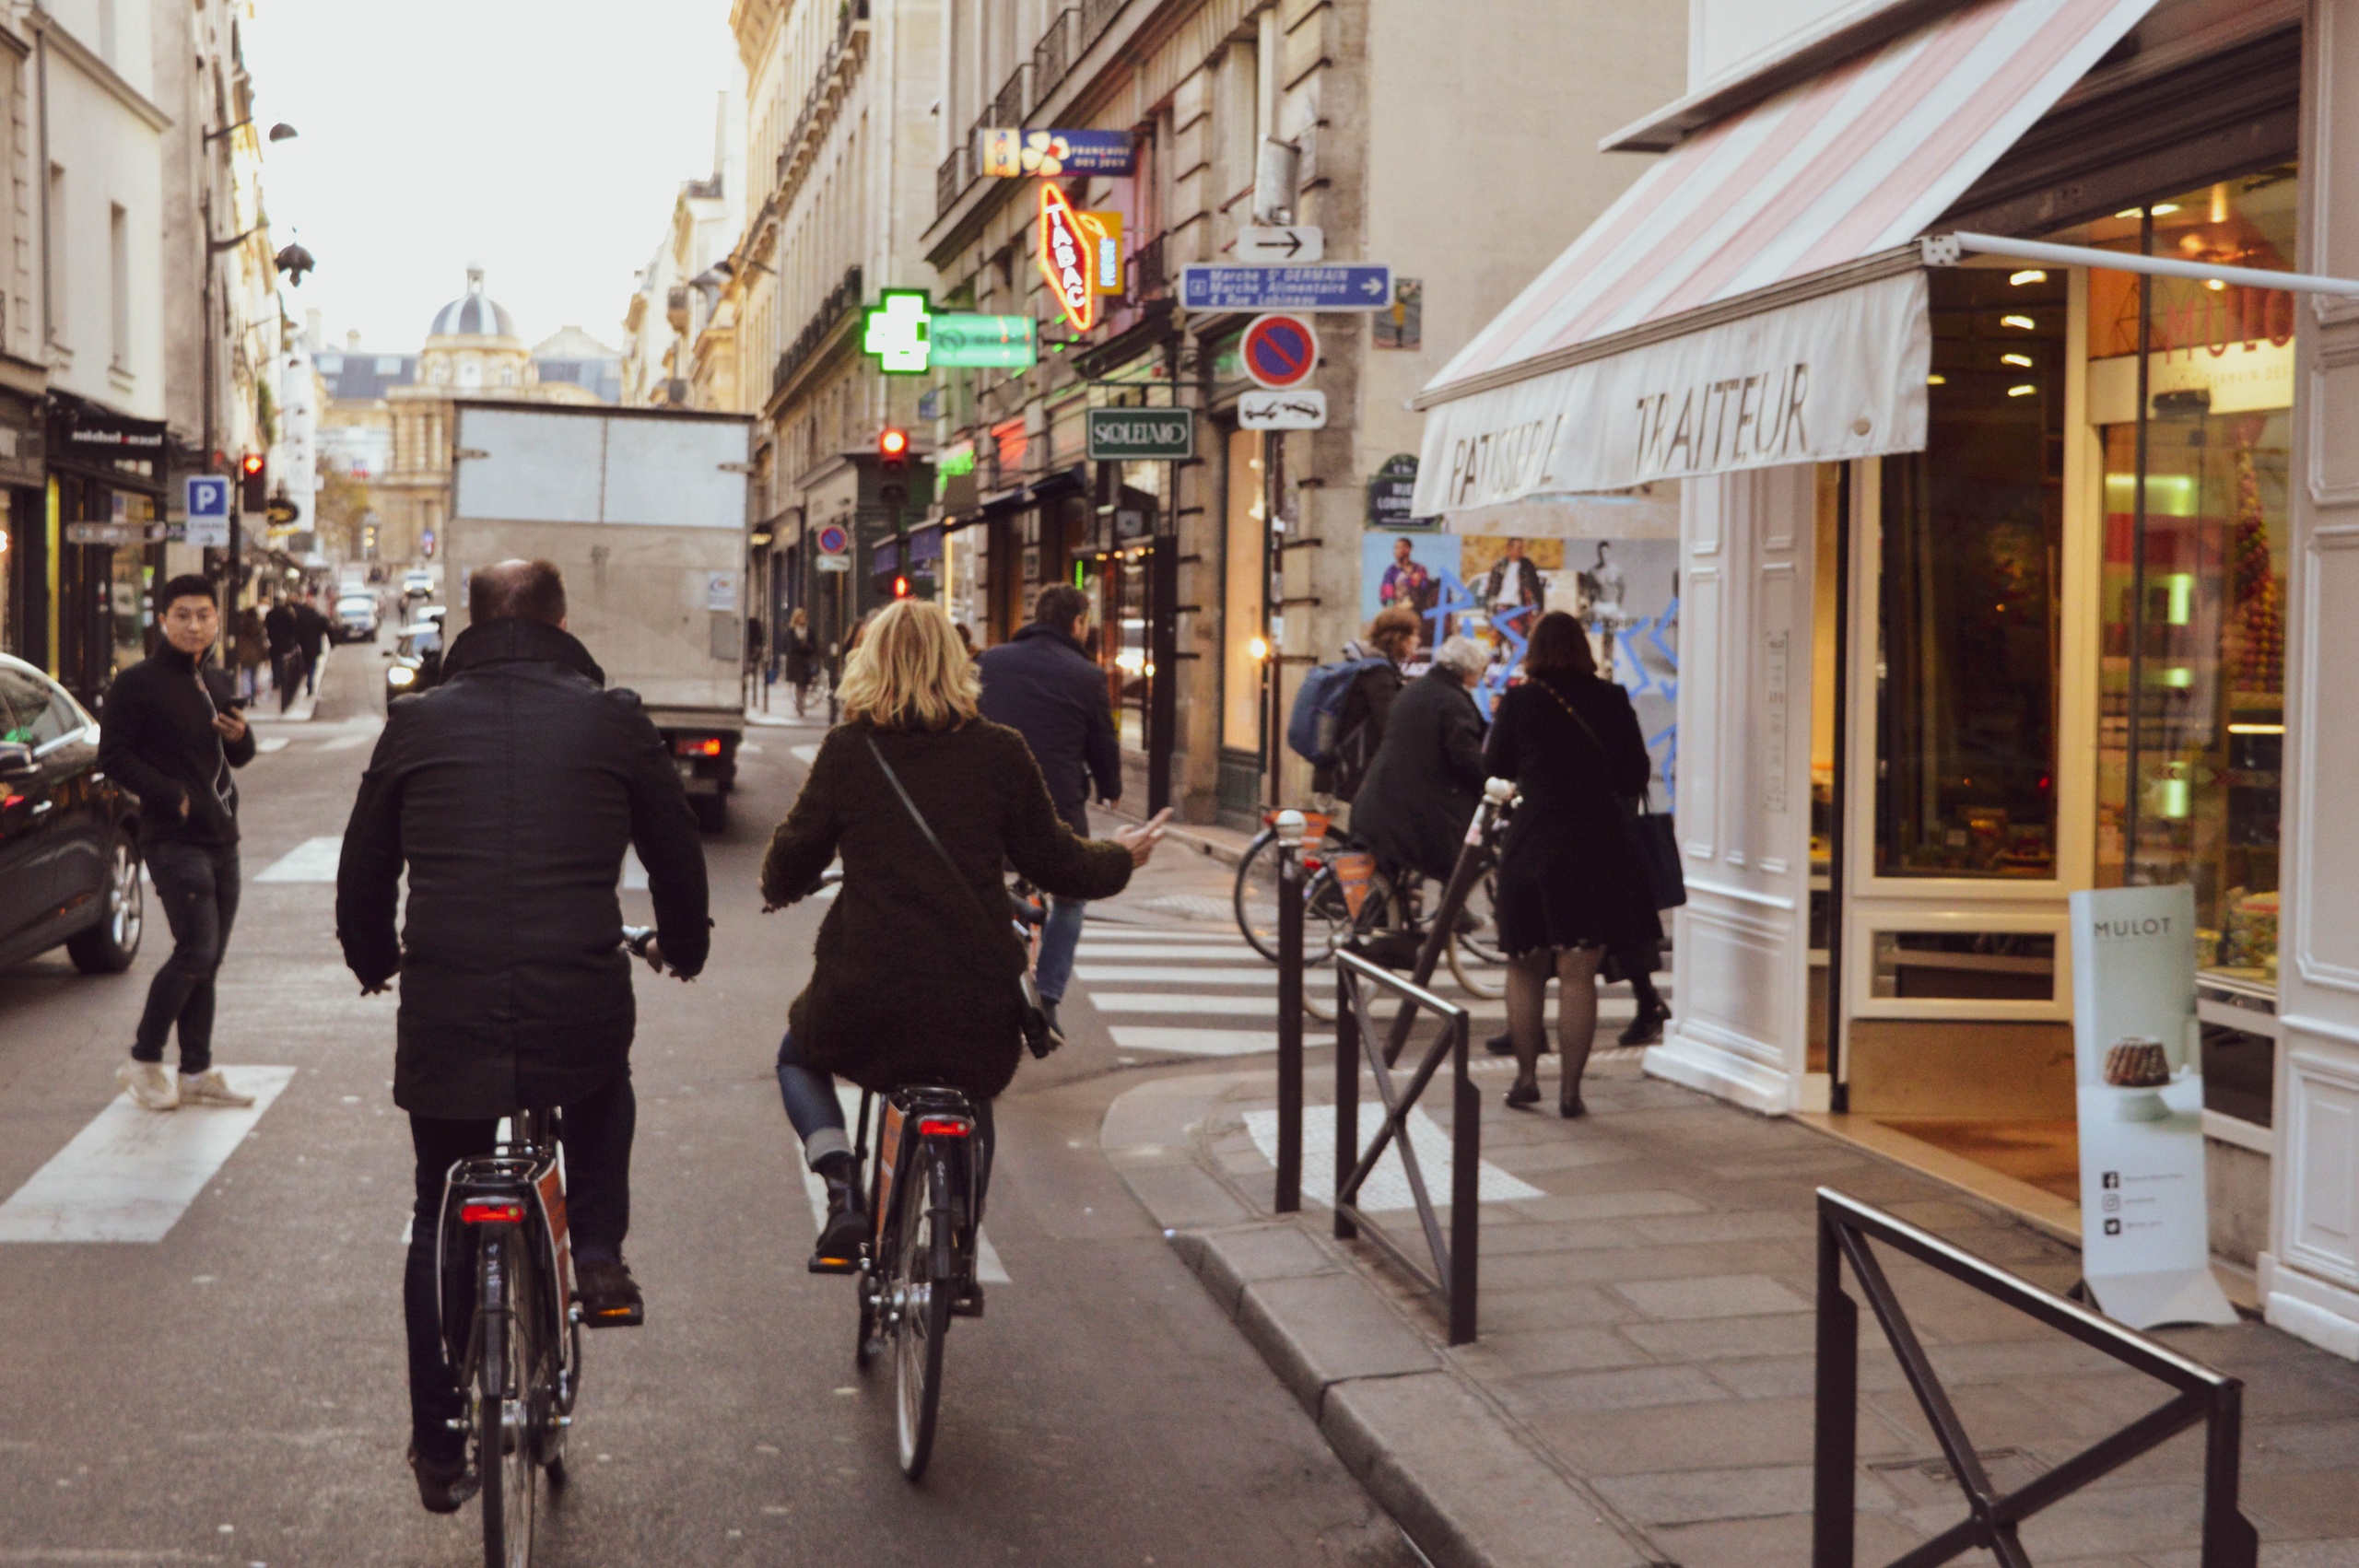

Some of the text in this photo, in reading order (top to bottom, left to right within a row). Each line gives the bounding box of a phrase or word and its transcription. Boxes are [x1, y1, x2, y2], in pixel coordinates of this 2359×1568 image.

[1044, 203, 1086, 308] TABAC
[1267, 281, 1347, 293] Alimentaire
[1226, 293, 1250, 306] Rue
[1636, 362, 1809, 477] TRAITEUR
[196, 485, 217, 512] P
[2094, 917, 2171, 937] MULOT
